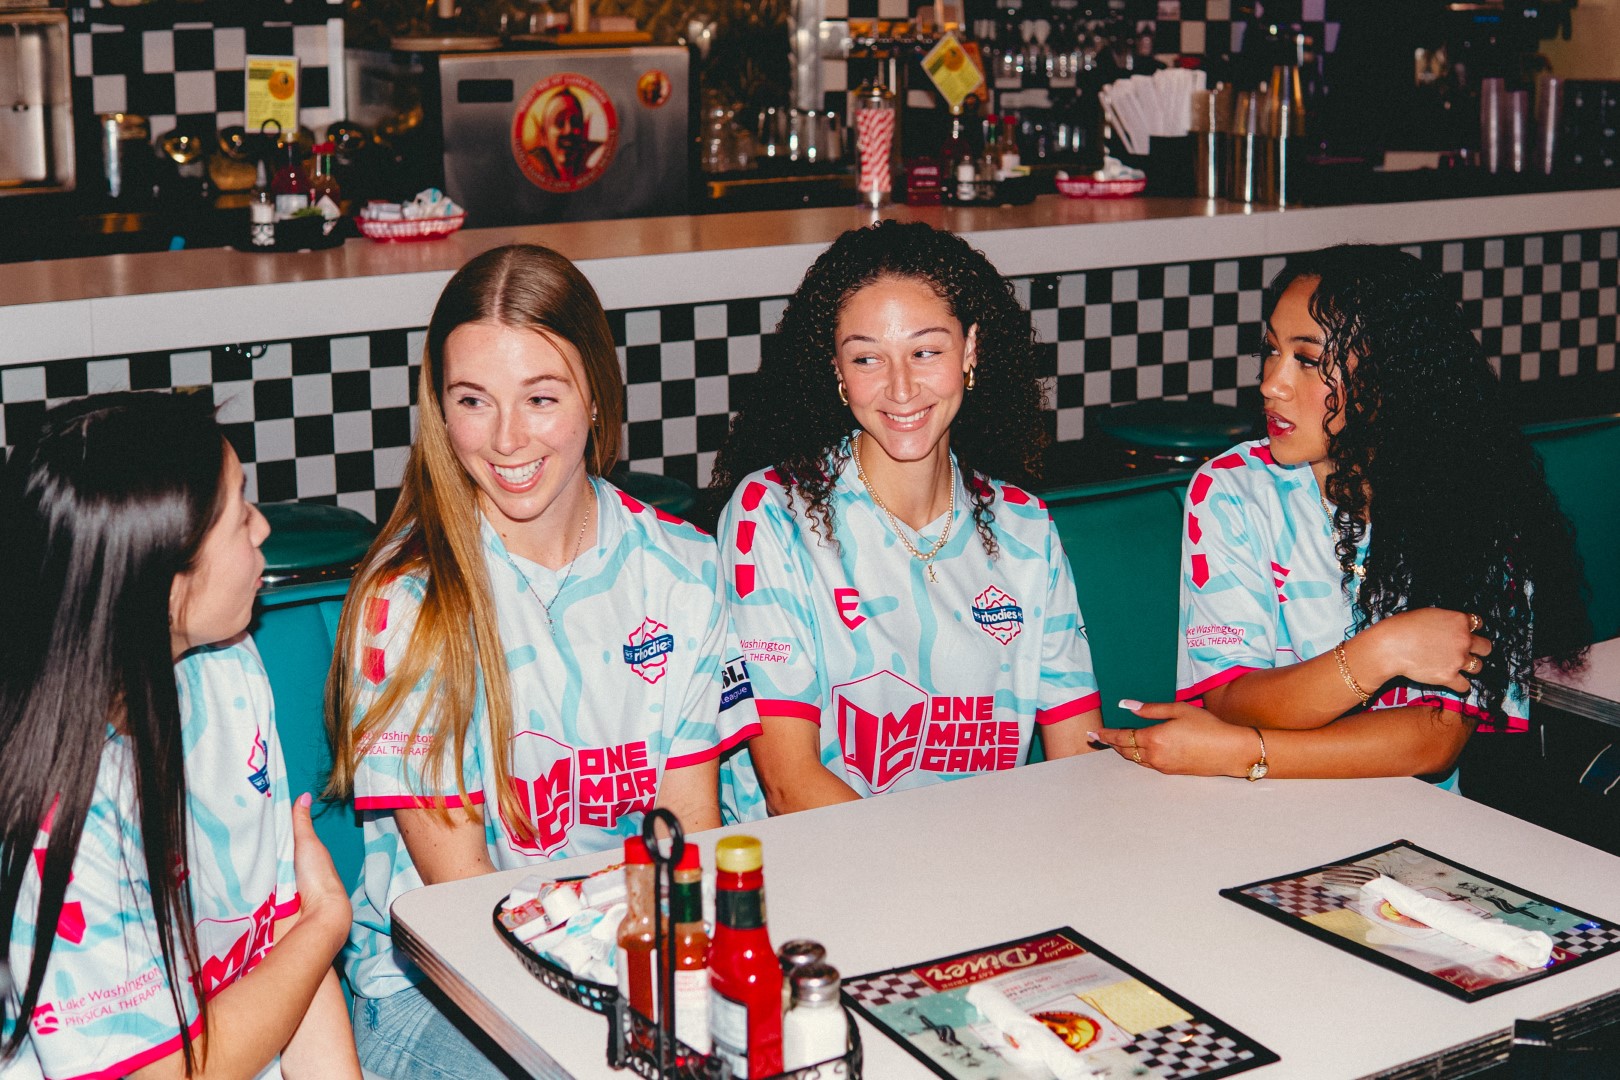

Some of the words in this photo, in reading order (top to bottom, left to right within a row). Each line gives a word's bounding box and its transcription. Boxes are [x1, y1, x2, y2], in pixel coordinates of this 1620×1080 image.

[981, 608, 1018, 622] rhodies
[1196, 624, 1244, 635] Washington
[1208, 637, 1242, 645] THERAPY
[750, 653, 788, 664] THERAPY
[931, 696, 994, 721] ONE
[925, 722, 1019, 747] MORE
[390, 746, 430, 756] THRAP
[578, 741, 648, 776] ONE
[919, 747, 1018, 772] GAME
[579, 768, 657, 804] MOR
[926, 947, 1038, 981] Diner
[58, 996, 86, 1012] Lake
[88, 967, 162, 1001] Washington
[65, 1004, 113, 1026] PHYSICAL
[118, 981, 163, 1010] THERAPY
